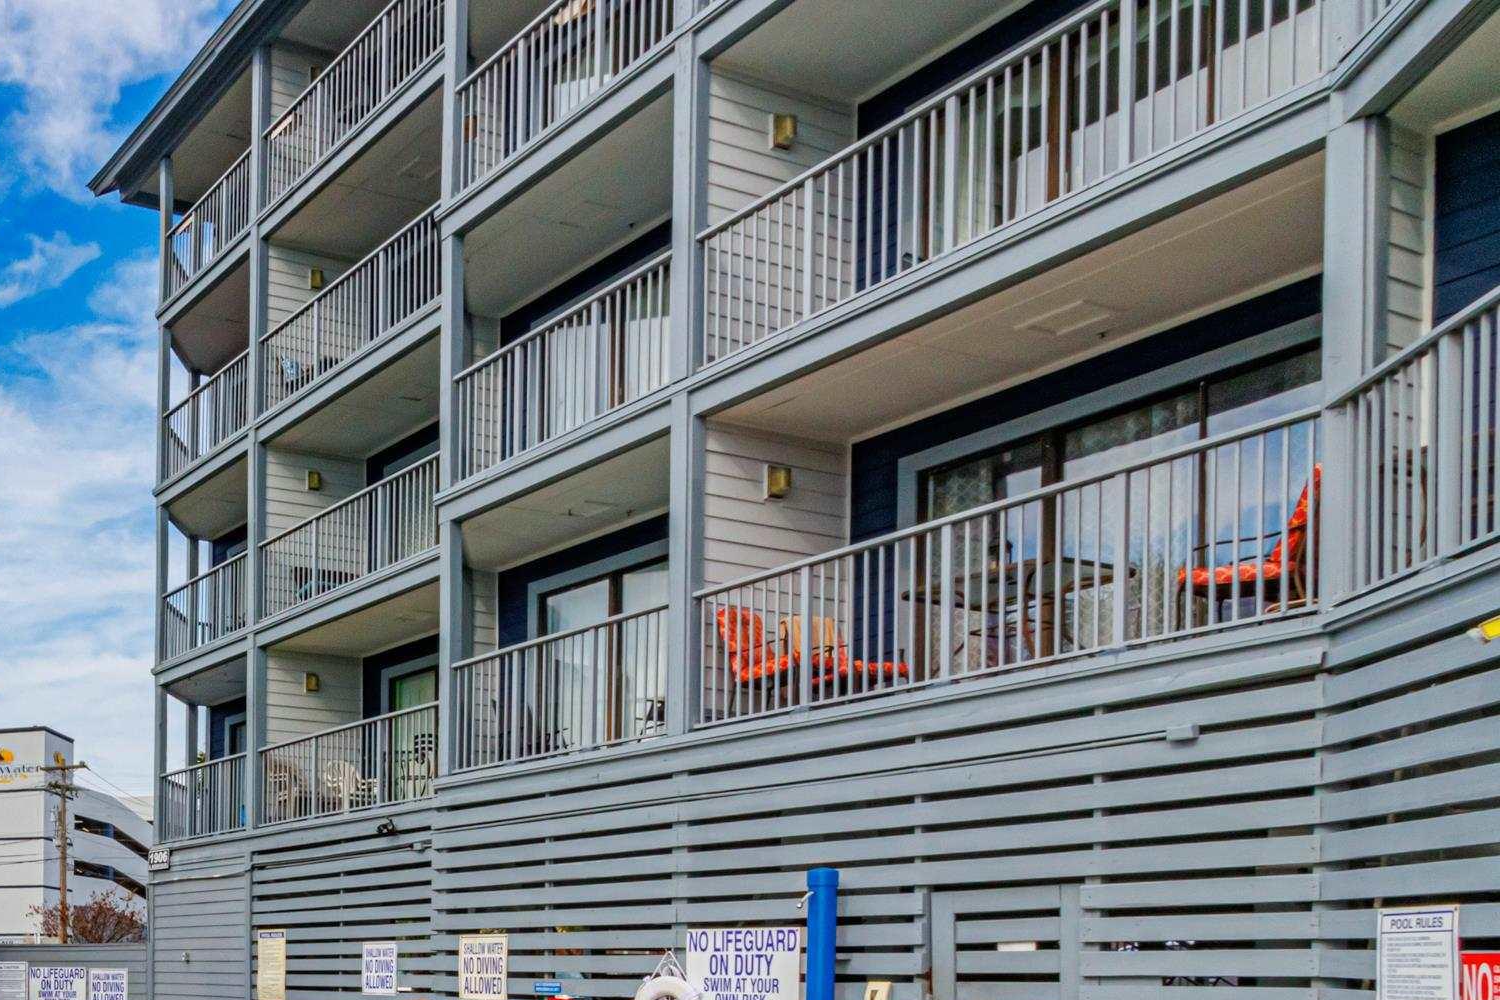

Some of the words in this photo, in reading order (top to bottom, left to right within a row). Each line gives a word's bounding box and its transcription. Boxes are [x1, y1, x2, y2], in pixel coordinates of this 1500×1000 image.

[149, 851, 168, 863] 1906
[1390, 919, 1413, 930] POOL
[1415, 917, 1443, 929] RULES
[688, 931, 709, 953] NO
[713, 930, 797, 952] LIFEGUARD
[464, 943, 485, 954] SHALLOW
[486, 943, 503, 954] WATER
[365, 960, 373, 973] NO
[375, 960, 394, 973] DIVING
[464, 957, 474, 974] NO
[477, 957, 503, 974] DIVING
[709, 954, 729, 976] ON
[735, 954, 774, 976] DUTY
[30, 968, 41, 979] NO
[43, 968, 85, 979] LIFEGUARD
[41, 980, 51, 990] ON
[54, 980, 74, 990] DUTY
[92, 981, 101, 993] NO
[103, 981, 125, 993] DIVING
[365, 975, 393, 989] ALLOWED
[464, 977, 502, 994] ALLOWED
[703, 977, 732, 992] SWIM
[735, 978, 747, 993] AT
[751, 978, 780, 994] YOUR
